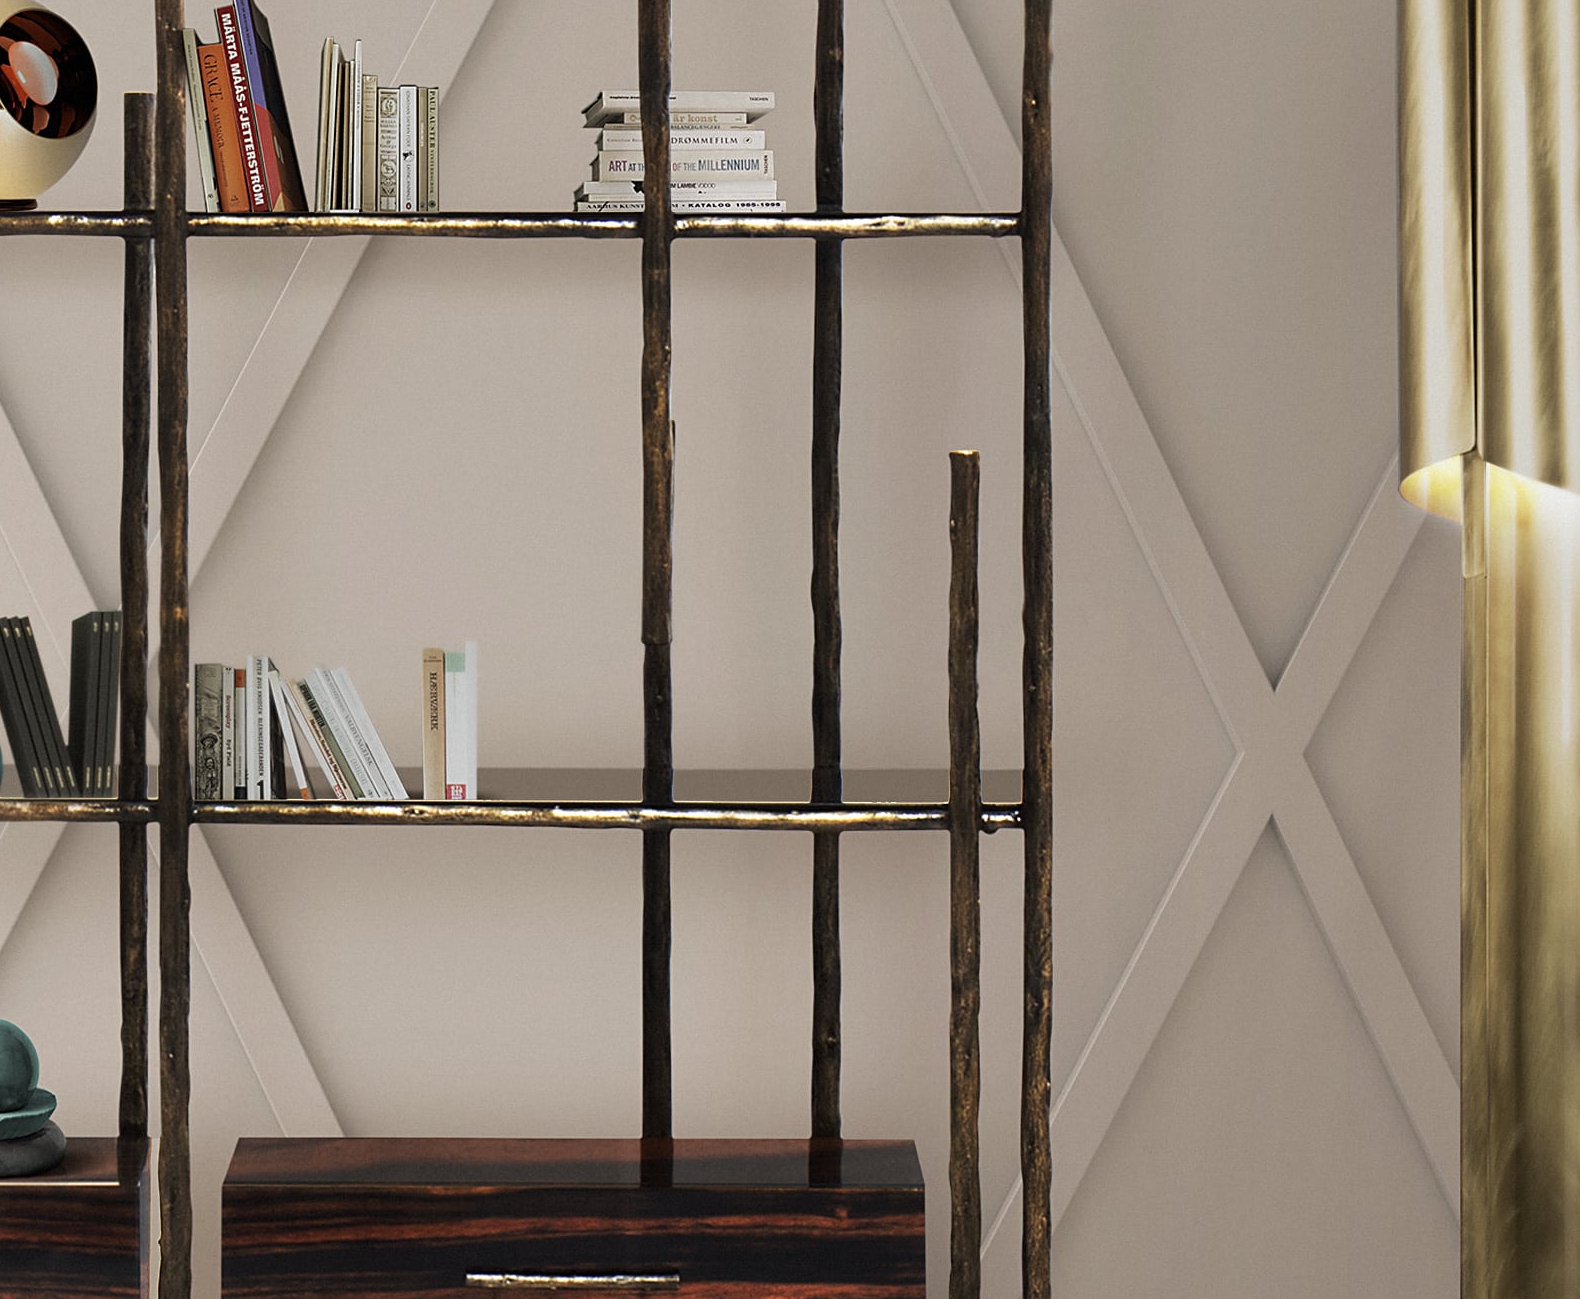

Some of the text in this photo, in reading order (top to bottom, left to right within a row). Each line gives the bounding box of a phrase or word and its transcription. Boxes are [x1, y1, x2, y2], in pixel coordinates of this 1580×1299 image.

[221, 13, 264, 206] MÄRTA MÅÅS-FJETTERSTRÖM
[688, 113, 718, 122] konst
[609, 160, 627, 171] ART
[628, 163, 636, 171] AT
[672, 163, 682, 171] OF
[683, 163, 697, 171] THE
[698, 159, 760, 171] MILLENNIUM
[430, 672, 438, 731] HÆRVÆRK
